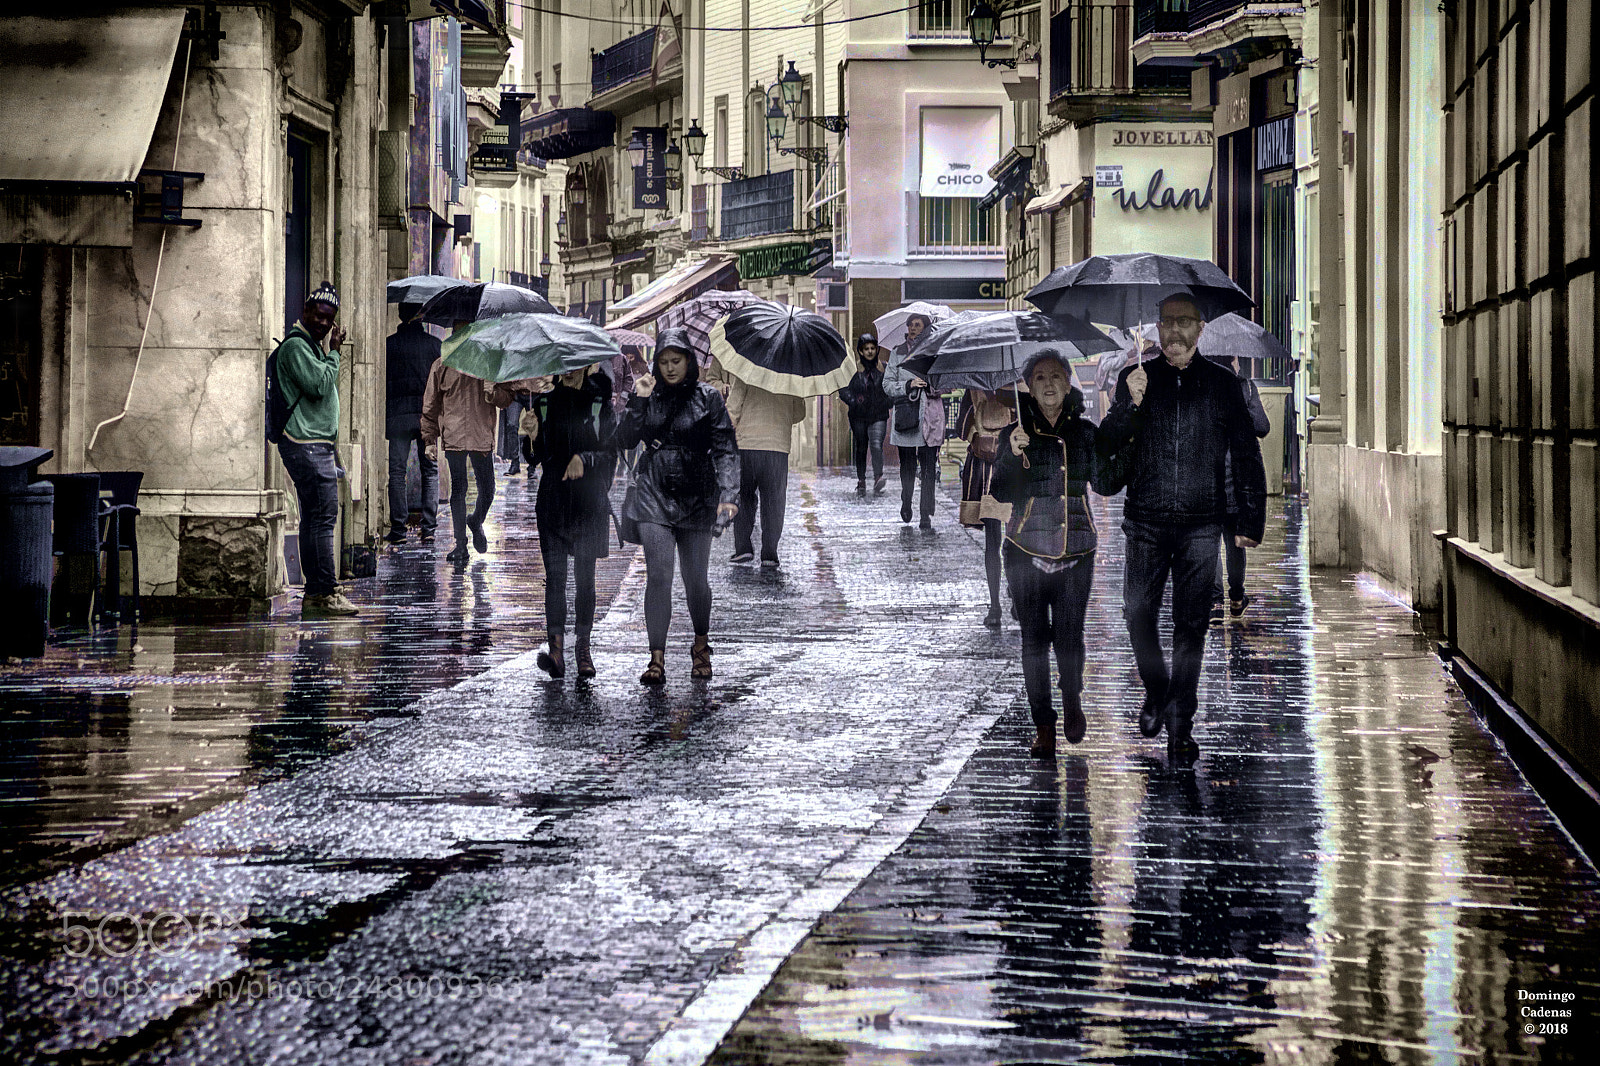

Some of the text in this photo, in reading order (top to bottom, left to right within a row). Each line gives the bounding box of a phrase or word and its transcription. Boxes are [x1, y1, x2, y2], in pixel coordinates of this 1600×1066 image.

[646, 133, 655, 161] rental
[1257, 118, 1289, 170] MARYPAZ
[937, 174, 984, 185] CHICO
[978, 282, 1004, 297] CH
